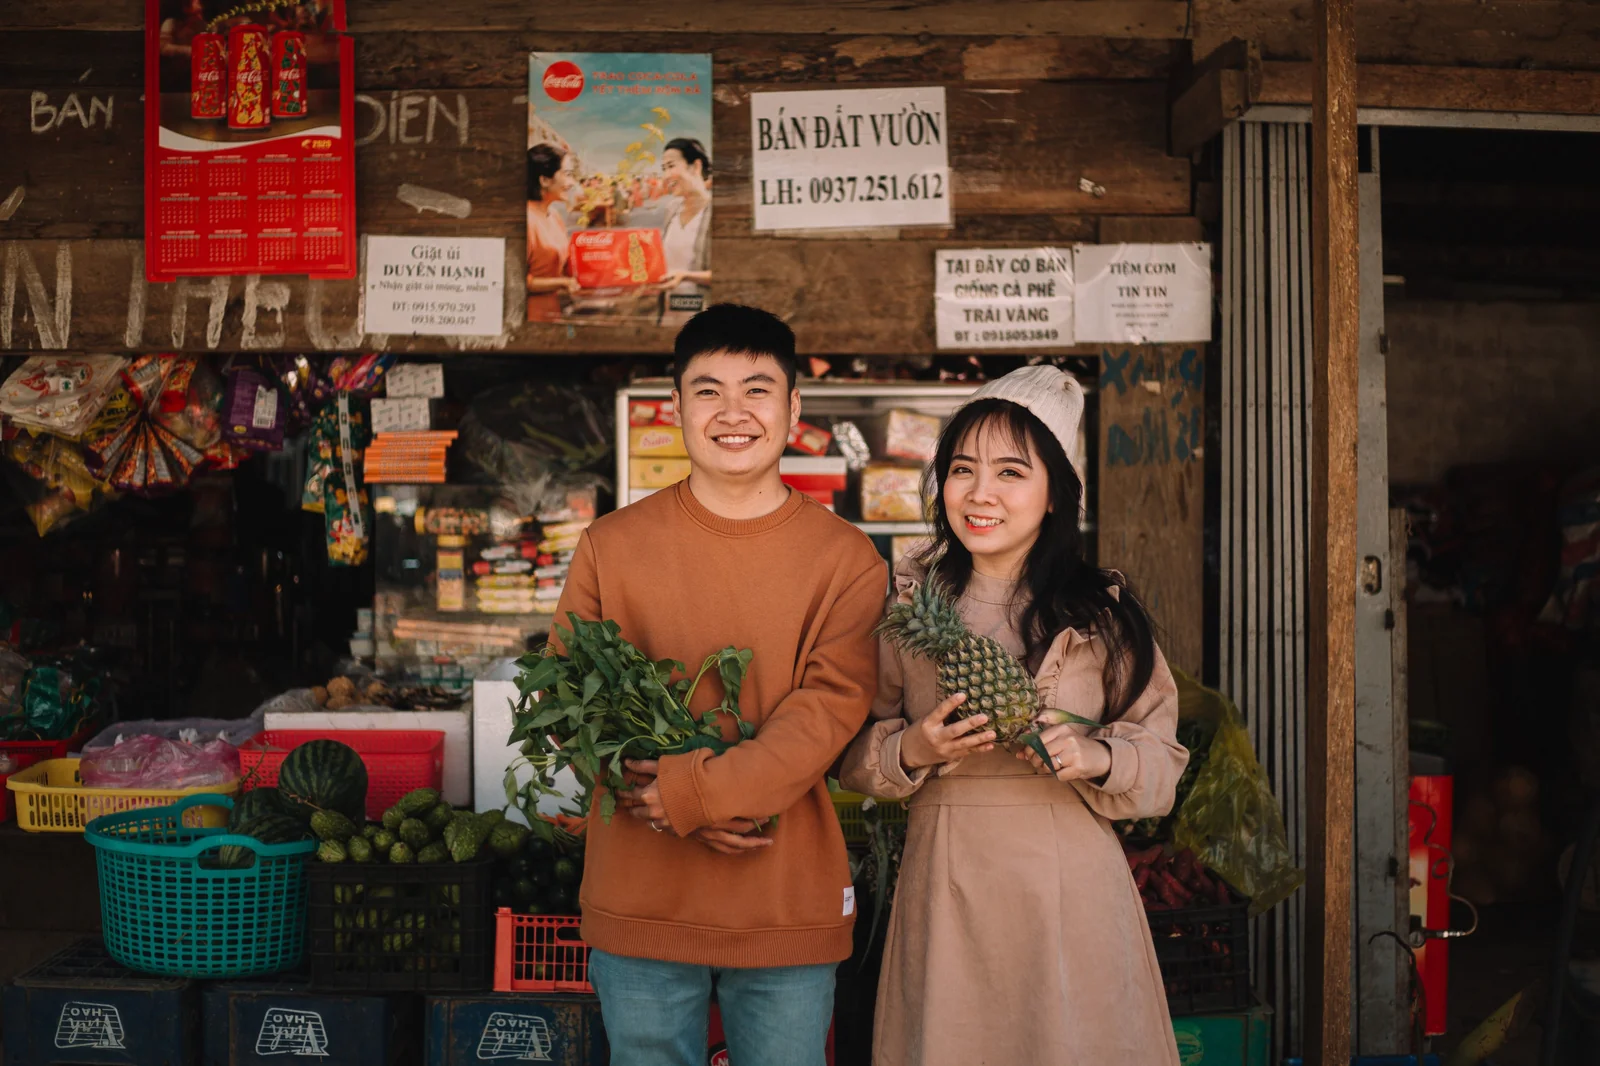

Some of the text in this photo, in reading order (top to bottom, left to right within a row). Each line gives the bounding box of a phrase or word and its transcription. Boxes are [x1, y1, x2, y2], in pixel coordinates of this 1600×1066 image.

[543, 74, 584, 89] Coca-Cola
[592, 71, 625, 81] TRAO
[758, 102, 941, 151] BÁN ĐẤT VƯỜN
[760, 173, 943, 205] LH: 0937.251.612
[383, 262, 485, 281] DUYÊN HẠNH
[945, 258, 970, 277] TẠI
[1027, 278, 1056, 298] PHÊ
